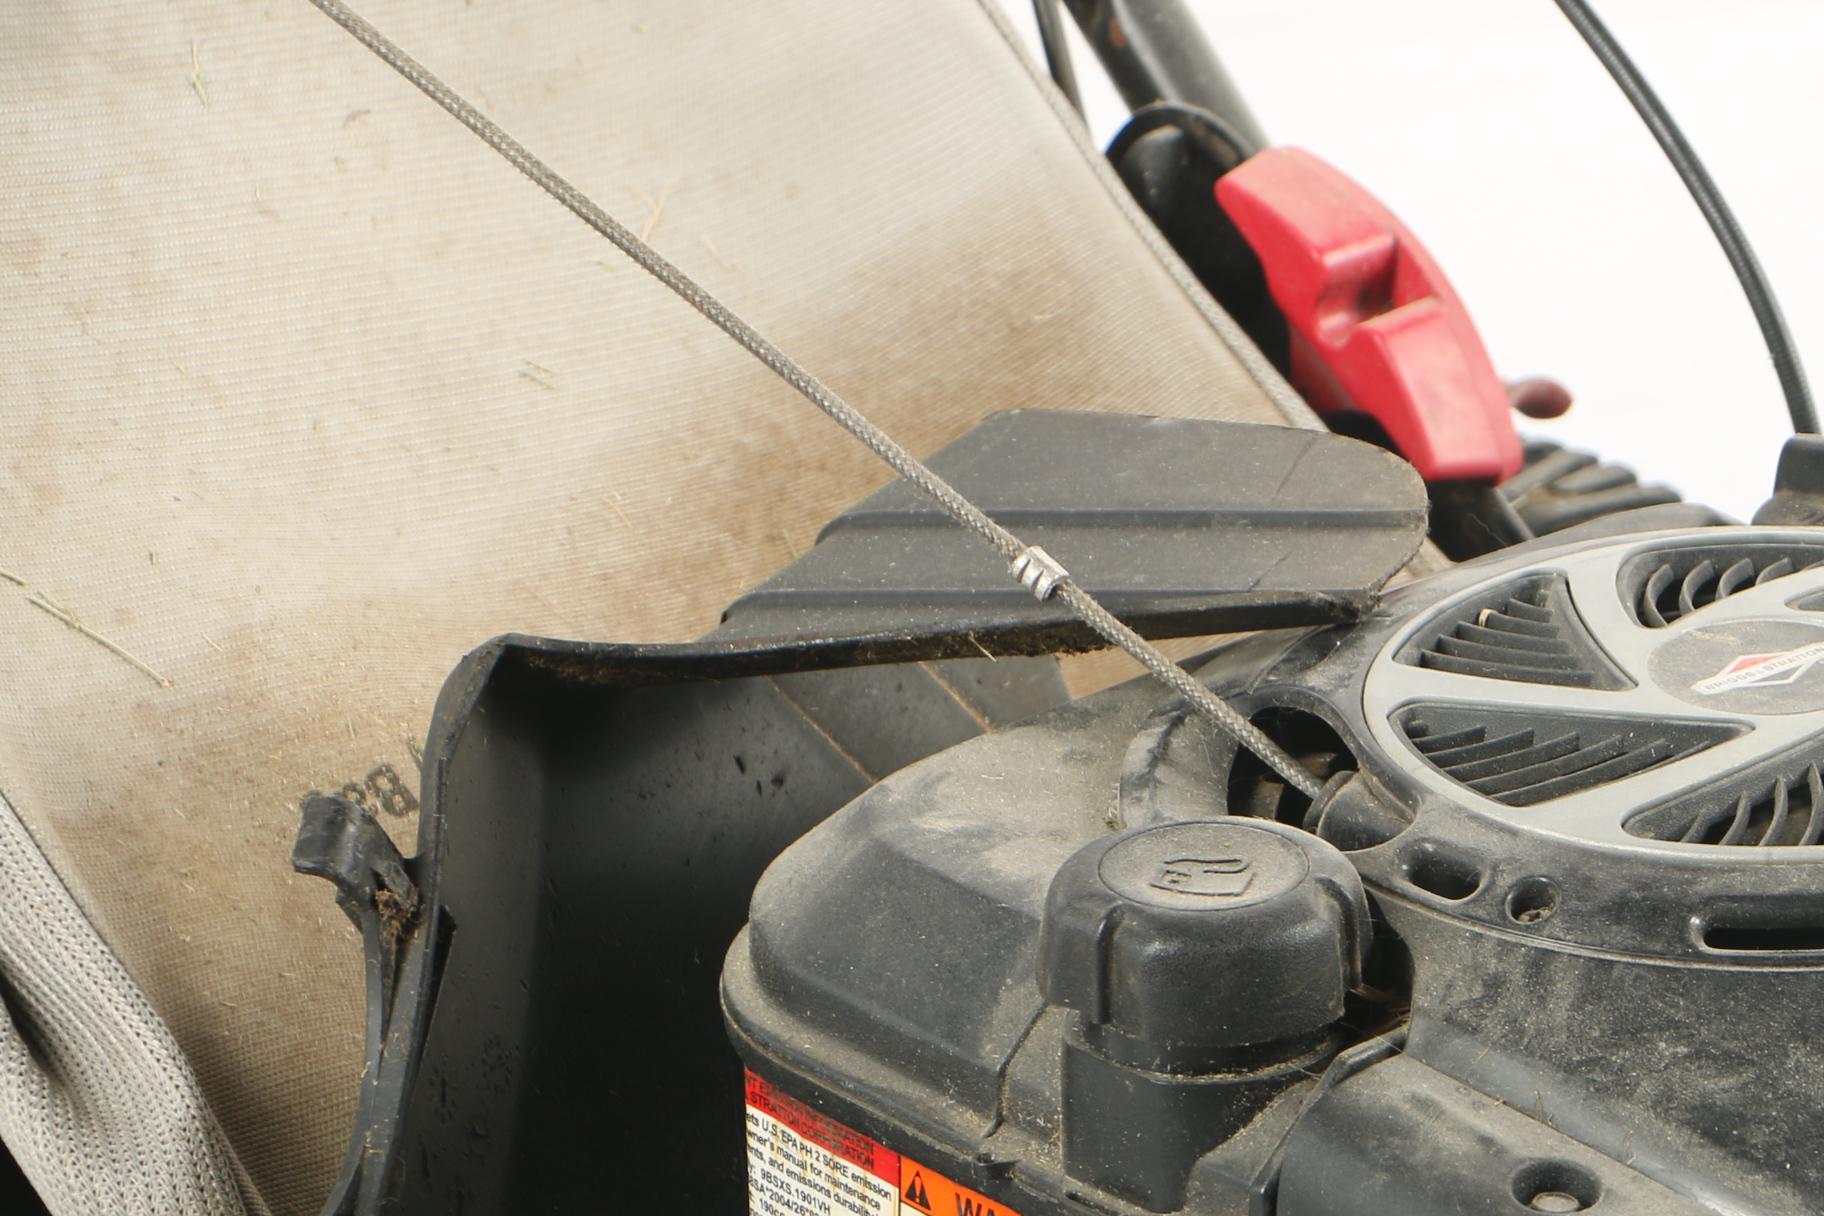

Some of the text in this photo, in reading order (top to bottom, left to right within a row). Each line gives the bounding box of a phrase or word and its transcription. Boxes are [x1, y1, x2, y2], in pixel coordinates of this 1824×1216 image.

[768, 1157, 785, 1173] and
[785, 1167, 832, 1199] emissions
[776, 1144, 808, 1171] manual
[810, 1159, 823, 1177] for
[824, 1173, 881, 1211] maintenance
[781, 1129, 798, 1150] EPA
[799, 1140, 813, 1158] PH
[815, 1150, 821, 1162] 2
[822, 1154, 849, 1179] SORE
[850, 1172, 892, 1201] emission
